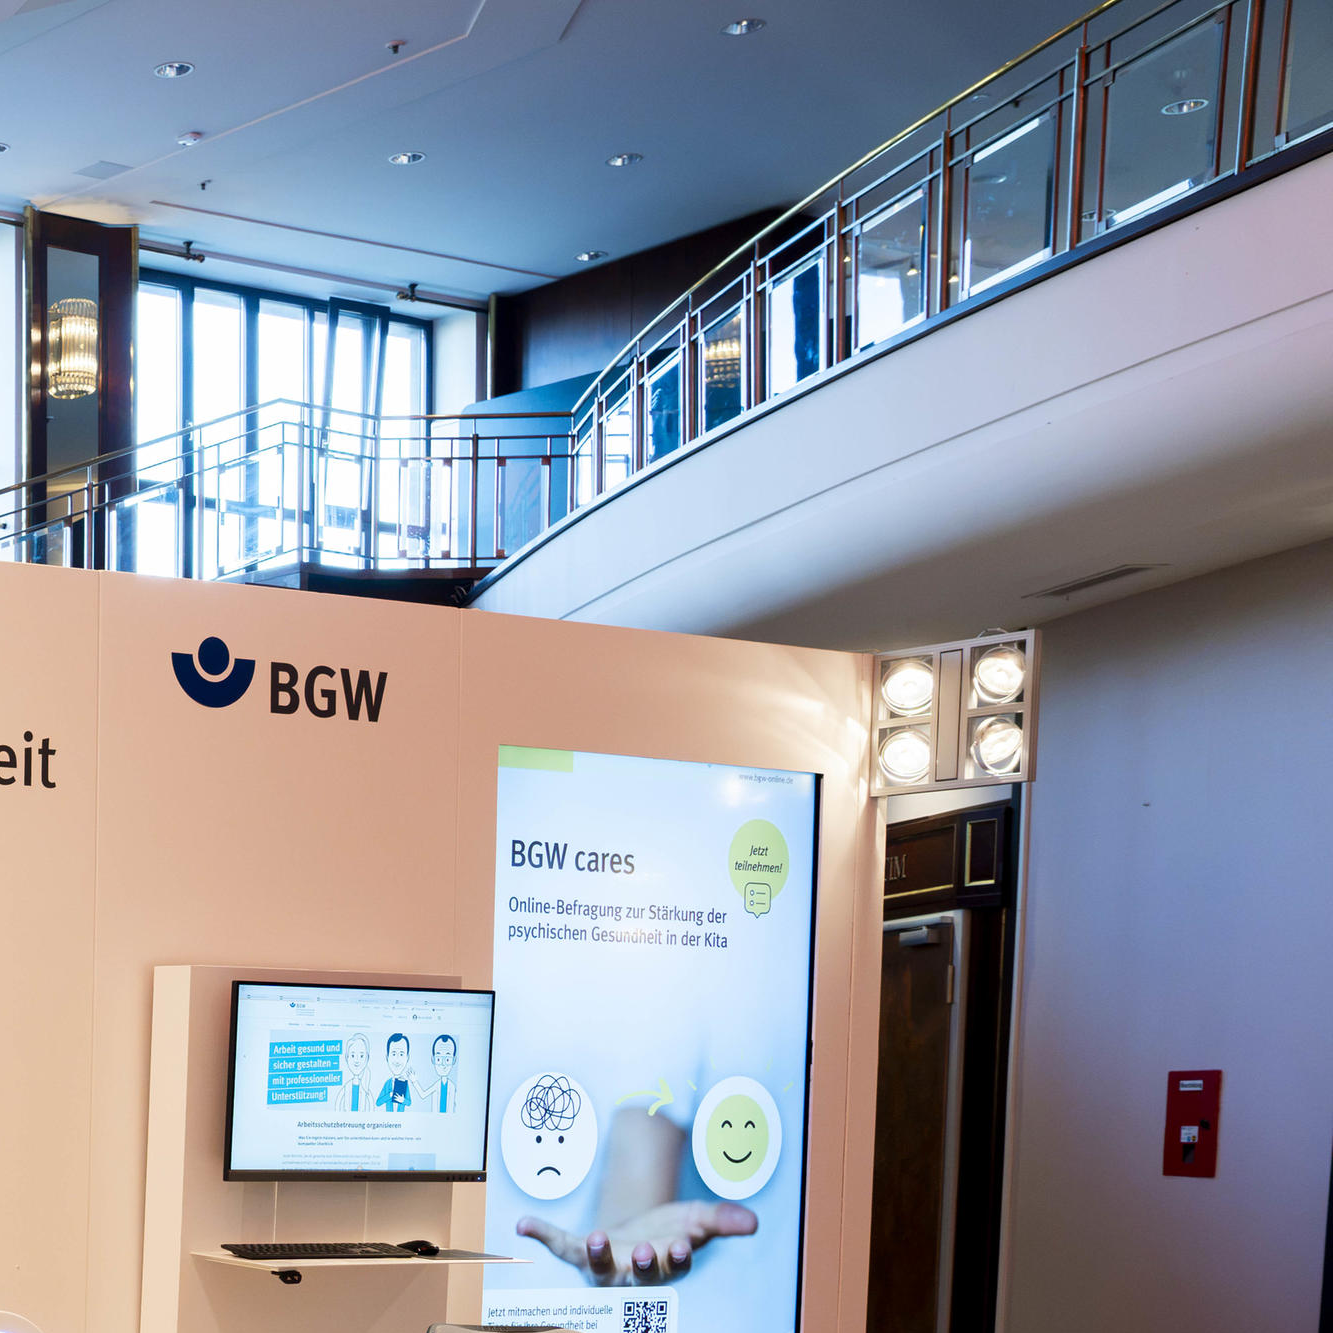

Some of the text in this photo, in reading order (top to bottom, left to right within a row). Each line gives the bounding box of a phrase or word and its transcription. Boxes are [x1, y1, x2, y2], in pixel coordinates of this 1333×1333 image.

[270, 661, 388, 723] BGW
[511, 839, 635, 875] BGW cares
[749, 845, 768, 856] Jetzt
[734, 860, 783, 873] teilnehmen!
[508, 896, 728, 926] Online-Befragung zur Stärkung der
[508, 922, 728, 949] psychischen Gesundheit in der Kita
[273, 1043, 341, 1057] Arbeit gesund und
[273, 1060, 295, 1070] sicher
[296, 1059, 331, 1071] gestalten
[272, 1074, 341, 1087] mit professioneller
[271, 1090, 327, 1103] Unterstützung!
[488, 1305, 613, 1318] Jetzt mitmachen und individuelle
